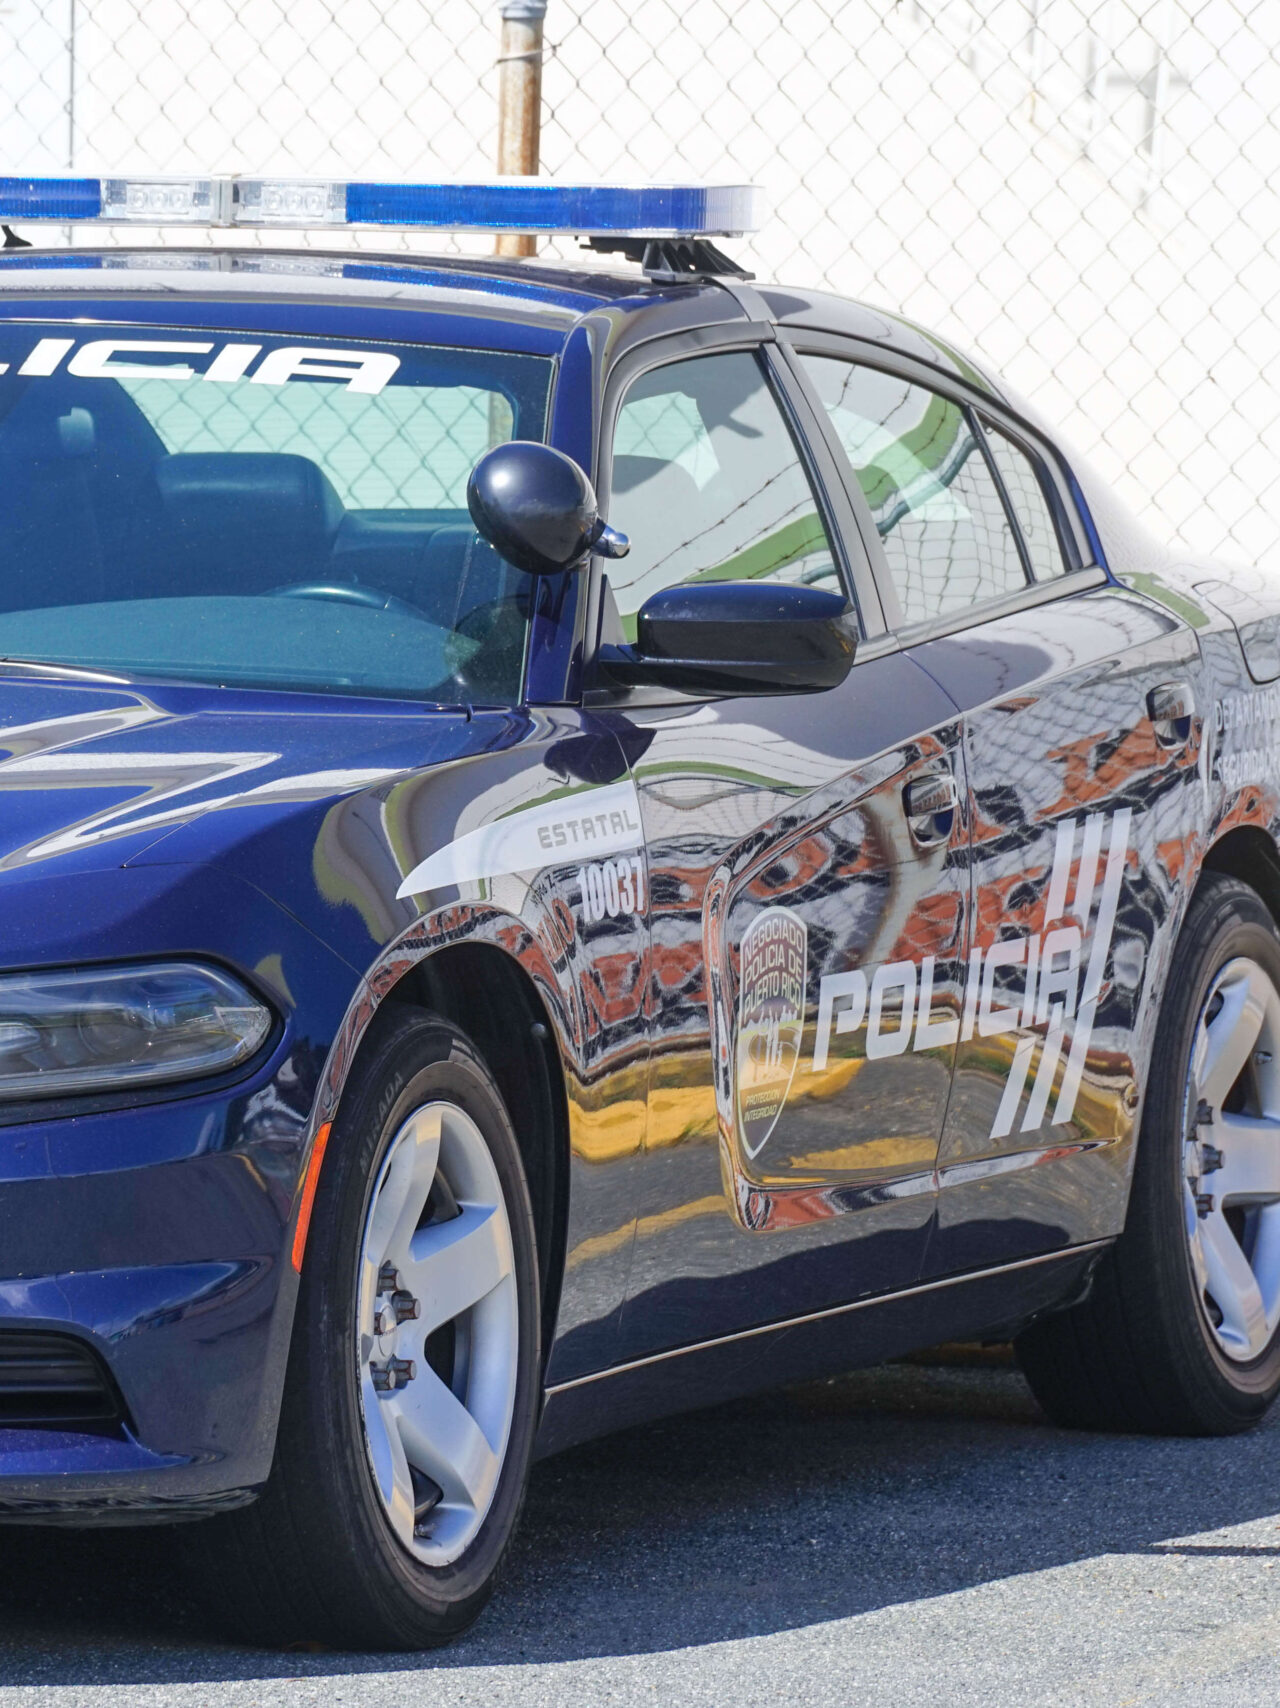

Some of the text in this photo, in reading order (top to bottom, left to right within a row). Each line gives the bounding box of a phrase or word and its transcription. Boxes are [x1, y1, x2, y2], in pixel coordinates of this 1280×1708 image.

[537, 810, 639, 849] ESTATAL
[576, 856, 644, 922] 10037
[744, 917, 803, 968] NEGOCIADO
[744, 943, 802, 994] POLICIA DE
[744, 970, 801, 1021] PUERTO RICO
[812, 925, 1082, 1073] POLICIA
[743, 1104, 778, 1122] INTEGRIDAD
